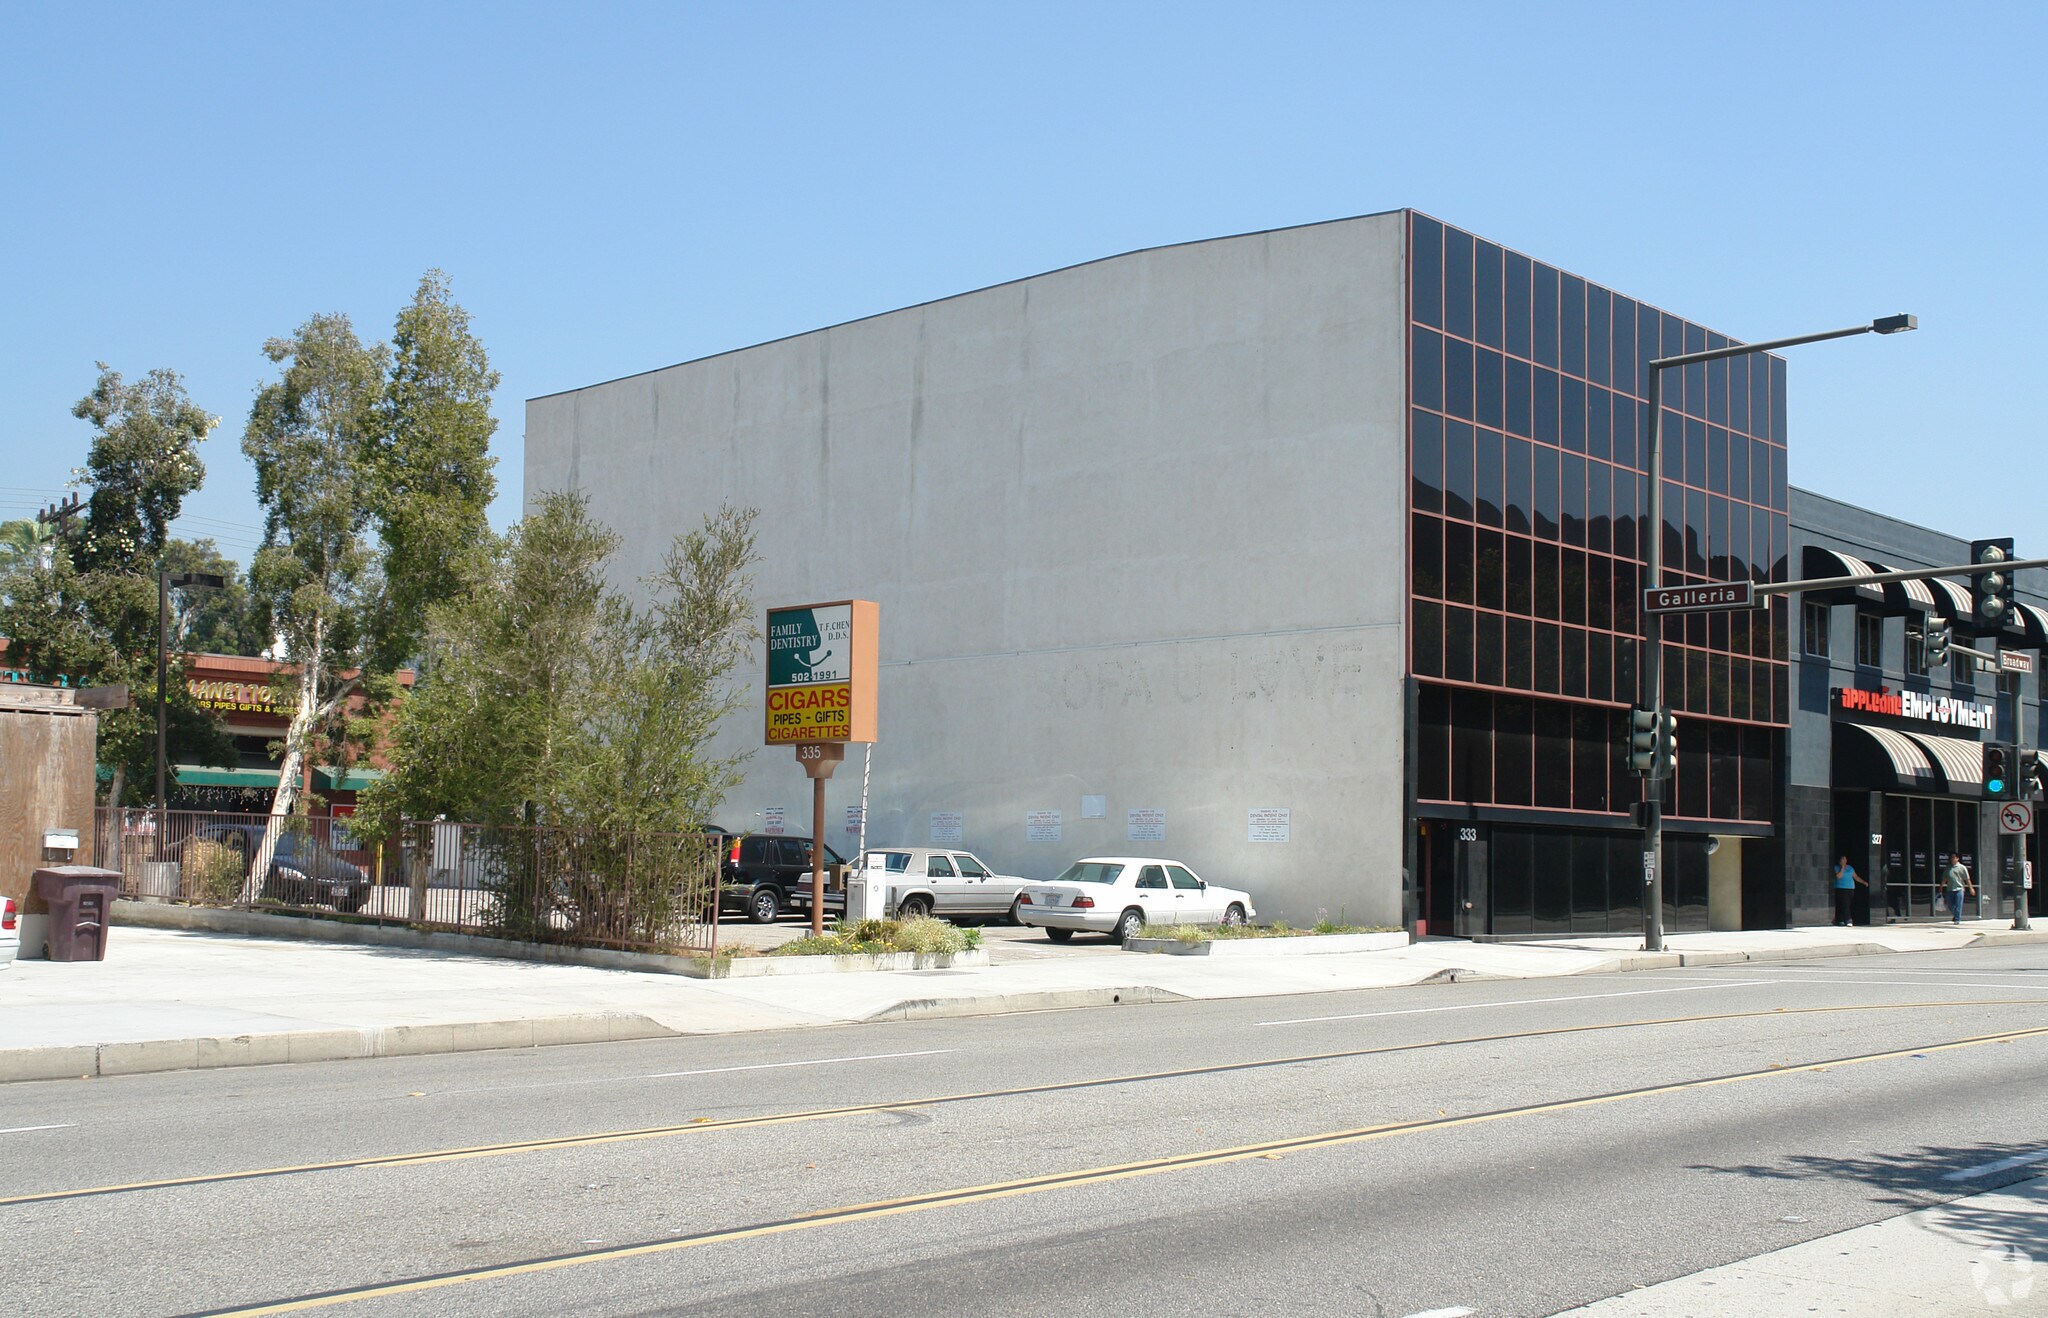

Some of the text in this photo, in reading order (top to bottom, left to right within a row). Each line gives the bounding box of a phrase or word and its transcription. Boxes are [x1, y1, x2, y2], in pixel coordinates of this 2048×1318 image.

[1659, 588, 1735, 606] Galleria
[771, 623, 803, 637] FAMILY
[828, 631, 849, 641] D.D.S.
[770, 635, 818, 650] DENTISTRY
[2002, 654, 2029, 671] Broadway
[791, 670, 837, 682] 502-1991
[214, 701, 237, 711] PIPES
[239, 703, 262, 712] GIFTS
[768, 688, 849, 711] CIGARS
[1902, 689, 1993, 730] EMPLOYMENT
[773, 712, 801, 725] PIPES
[815, 710, 845, 724] GIFTS
[768, 725, 849, 740] CIGARETTES
[801, 745, 821, 760] 335
[1460, 827, 1477, 841] 333
[1871, 833, 1883, 845] 327
